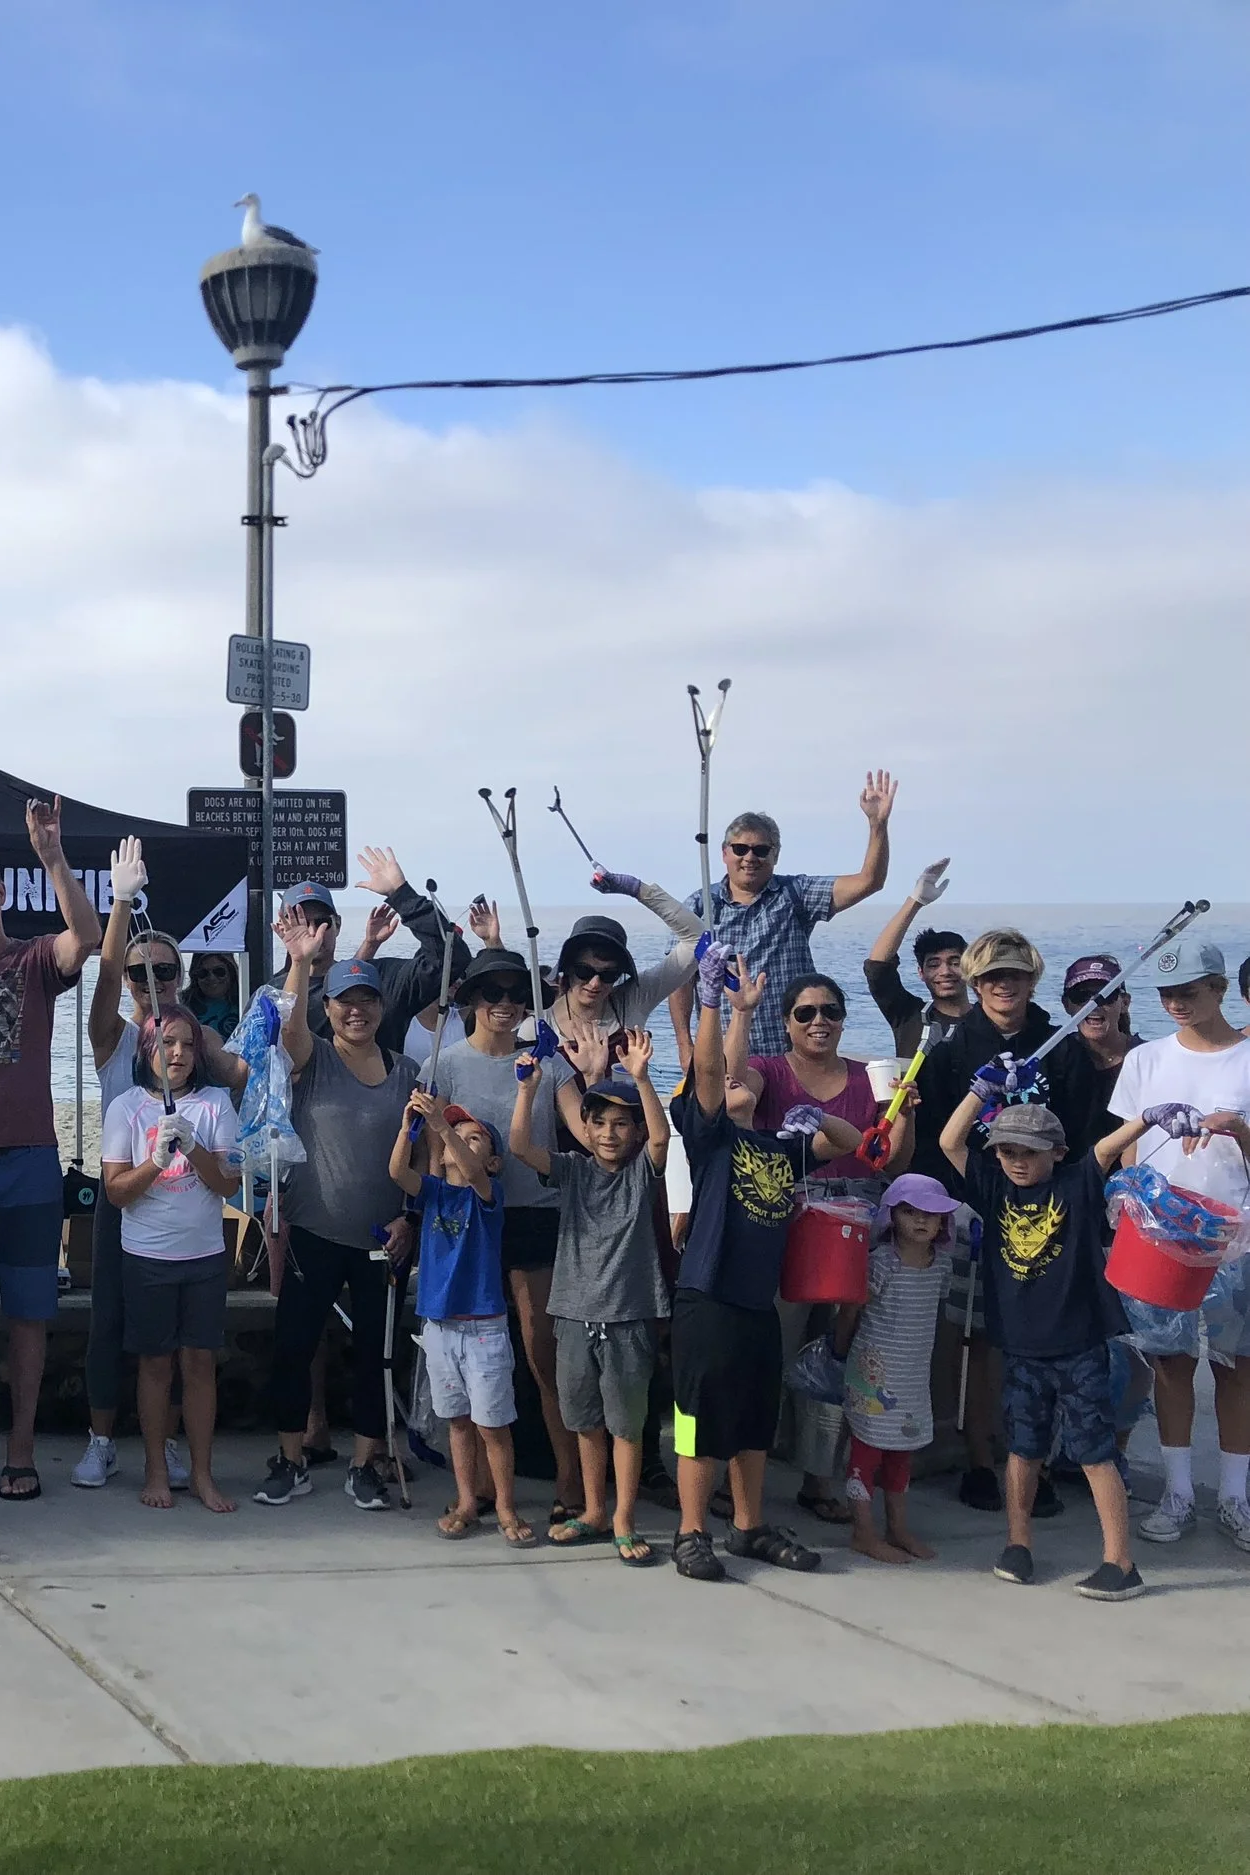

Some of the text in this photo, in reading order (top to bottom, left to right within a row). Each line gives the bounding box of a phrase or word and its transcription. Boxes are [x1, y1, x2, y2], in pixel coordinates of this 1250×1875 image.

[271, 648, 296, 660] ATING
[238, 658, 300, 674] SKATEARDING
[246, 672, 292, 688] PROITED
[235, 686, 264, 699] O.C.C.O
[204, 797, 331, 809] DOGS ARE NOT RMITTED ON THE
[195, 812, 230, 822] BEACHES
[233, 813, 263, 822] BETWEE
[287, 813, 301, 823] AND
[305, 813, 319, 823] 6PM
[321, 814, 340, 823] FROM
[289, 827, 305, 837] 10th.
[308, 828, 327, 837] DOGS
[329, 828, 342, 837] ARE
[272, 842, 291, 852] EASH
[294, 842, 304, 852] AT
[306, 843, 320, 852] ANY
[323, 843, 341, 852] TIME.
[295, 856, 314, 866] YOUR
[317, 857, 332, 866] PET.
[203, 901, 236, 943] ASC
[731, 1184, 744, 1200] CUB
[743, 1200, 768, 1218] SCOUT
